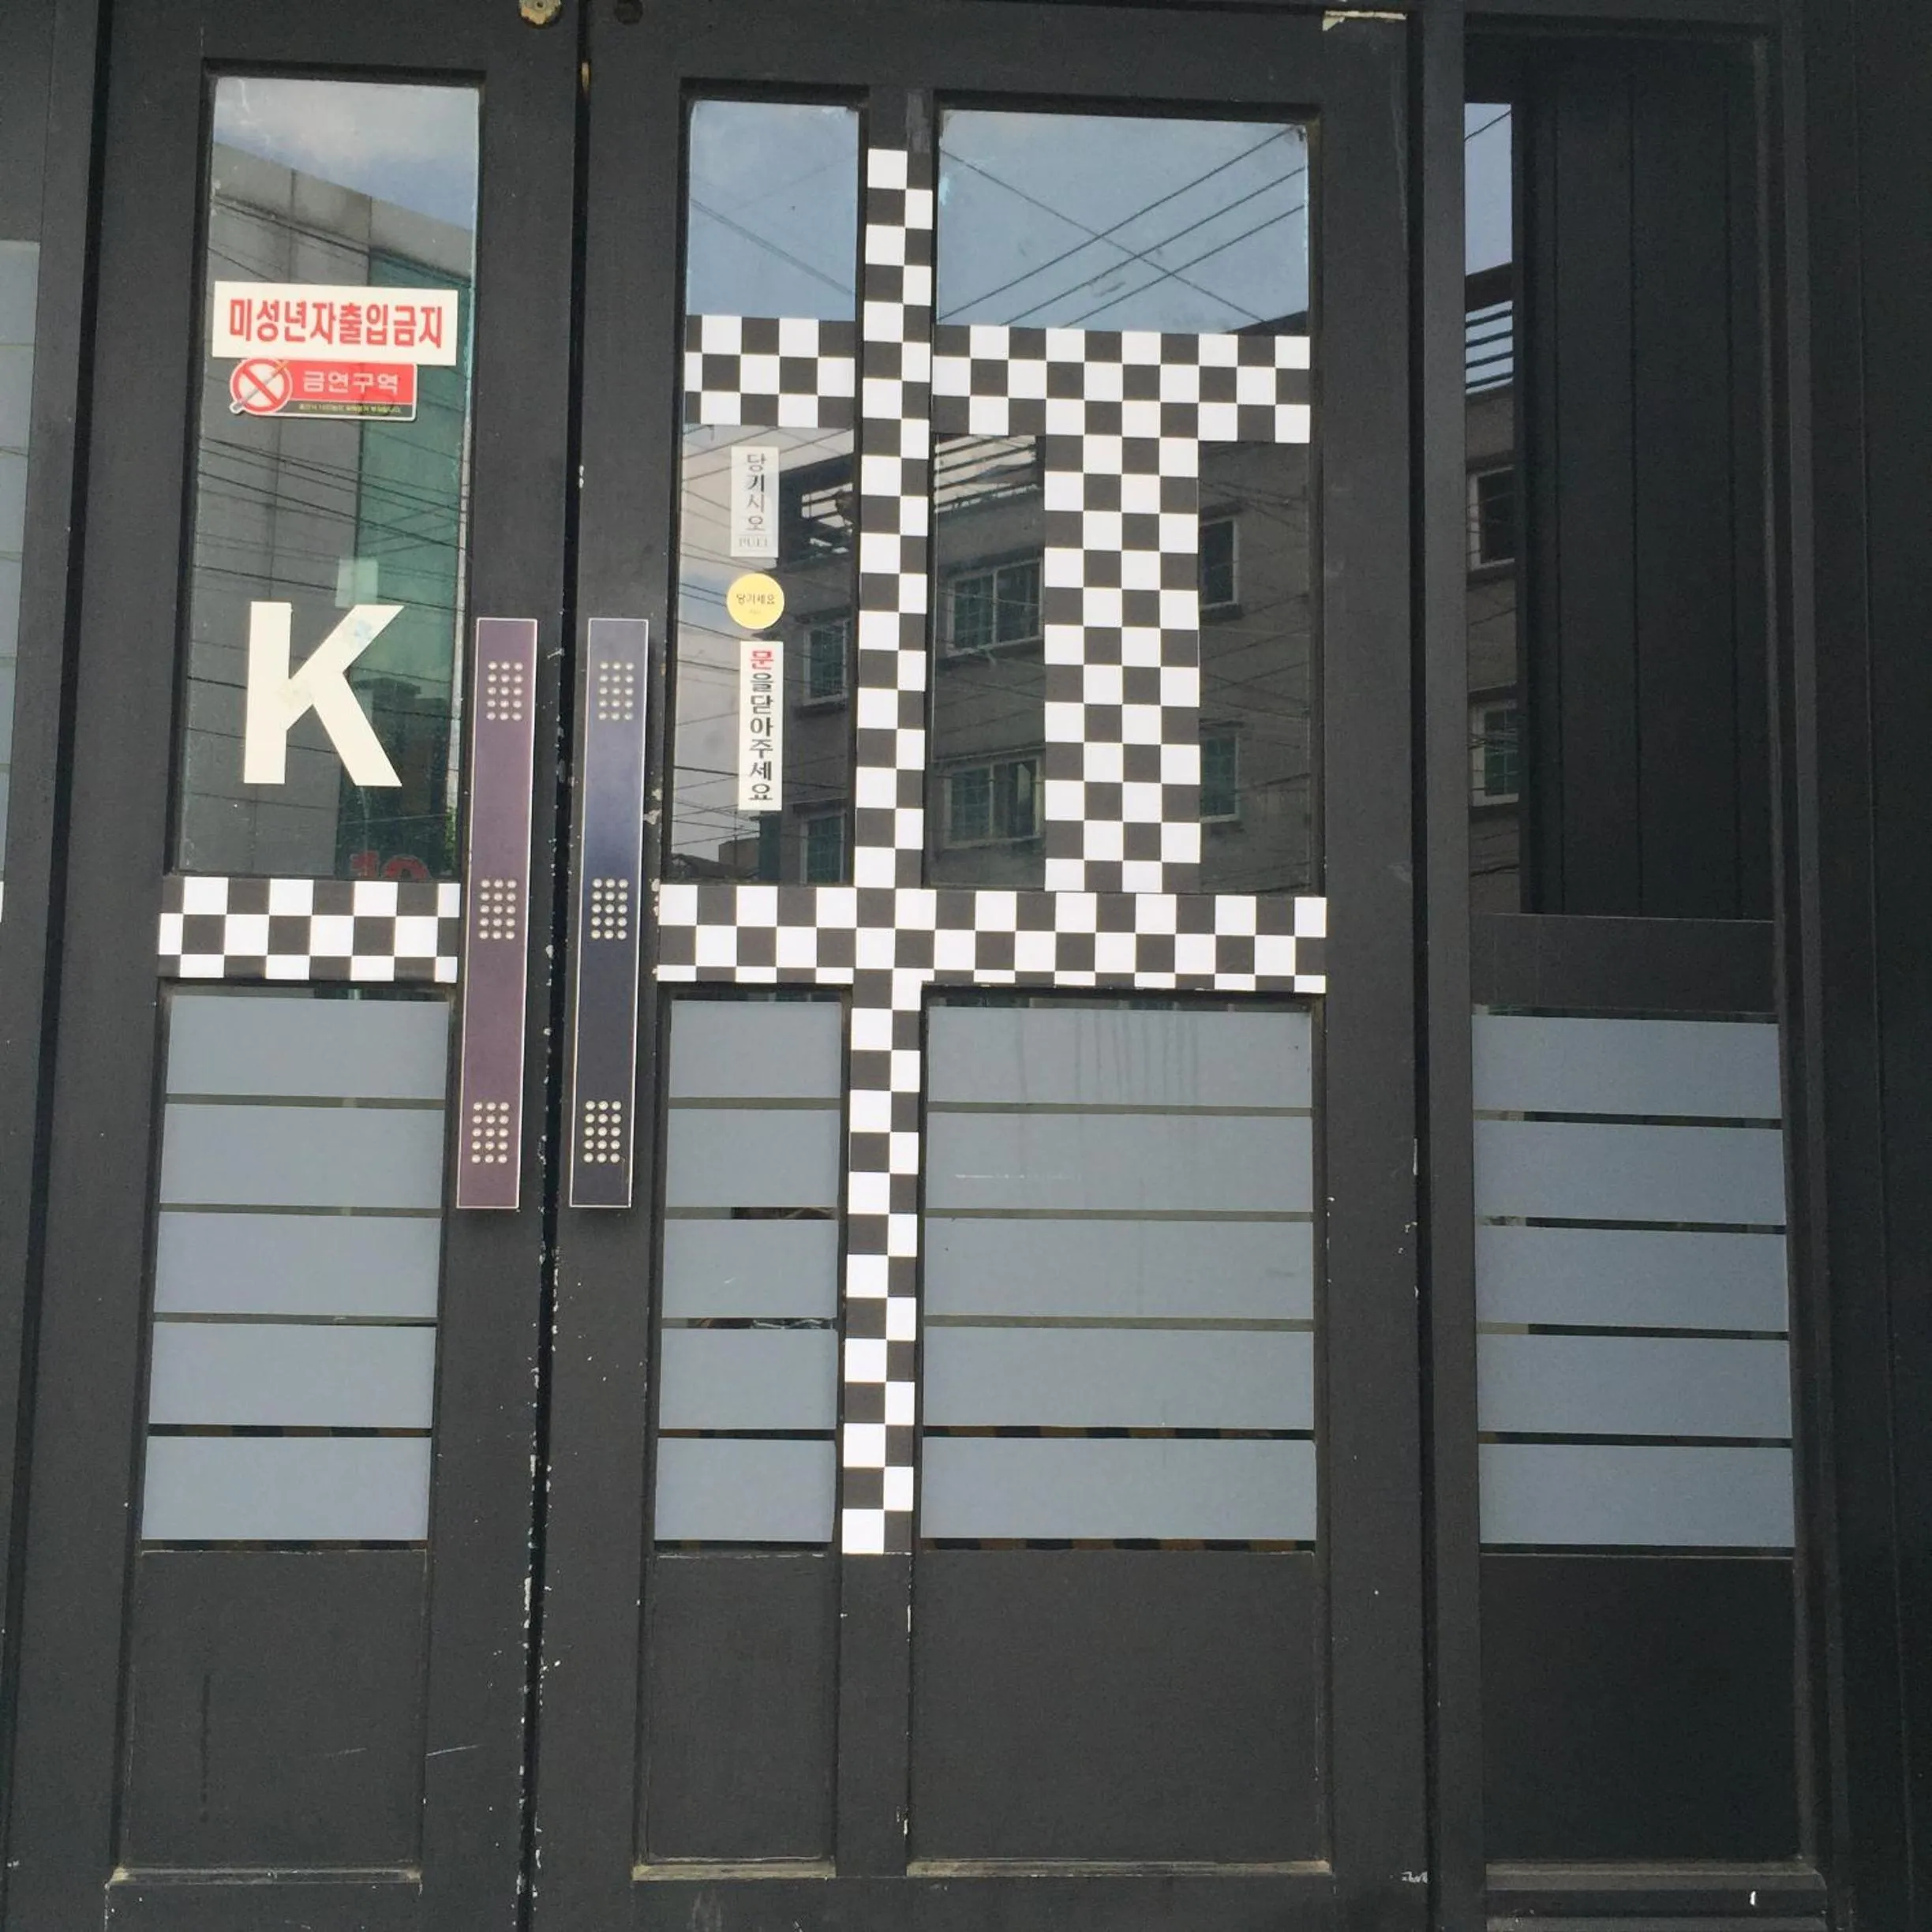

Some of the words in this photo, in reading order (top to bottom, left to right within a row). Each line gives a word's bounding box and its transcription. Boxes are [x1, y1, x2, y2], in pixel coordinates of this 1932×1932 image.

[229, 298, 444, 349] 미성년자출입금지
[302, 370, 399, 395] 금연구역
[746, 452, 767, 532] 당기시오
[736, 593, 776, 606] 당기세요
[244, 601, 405, 787] K
